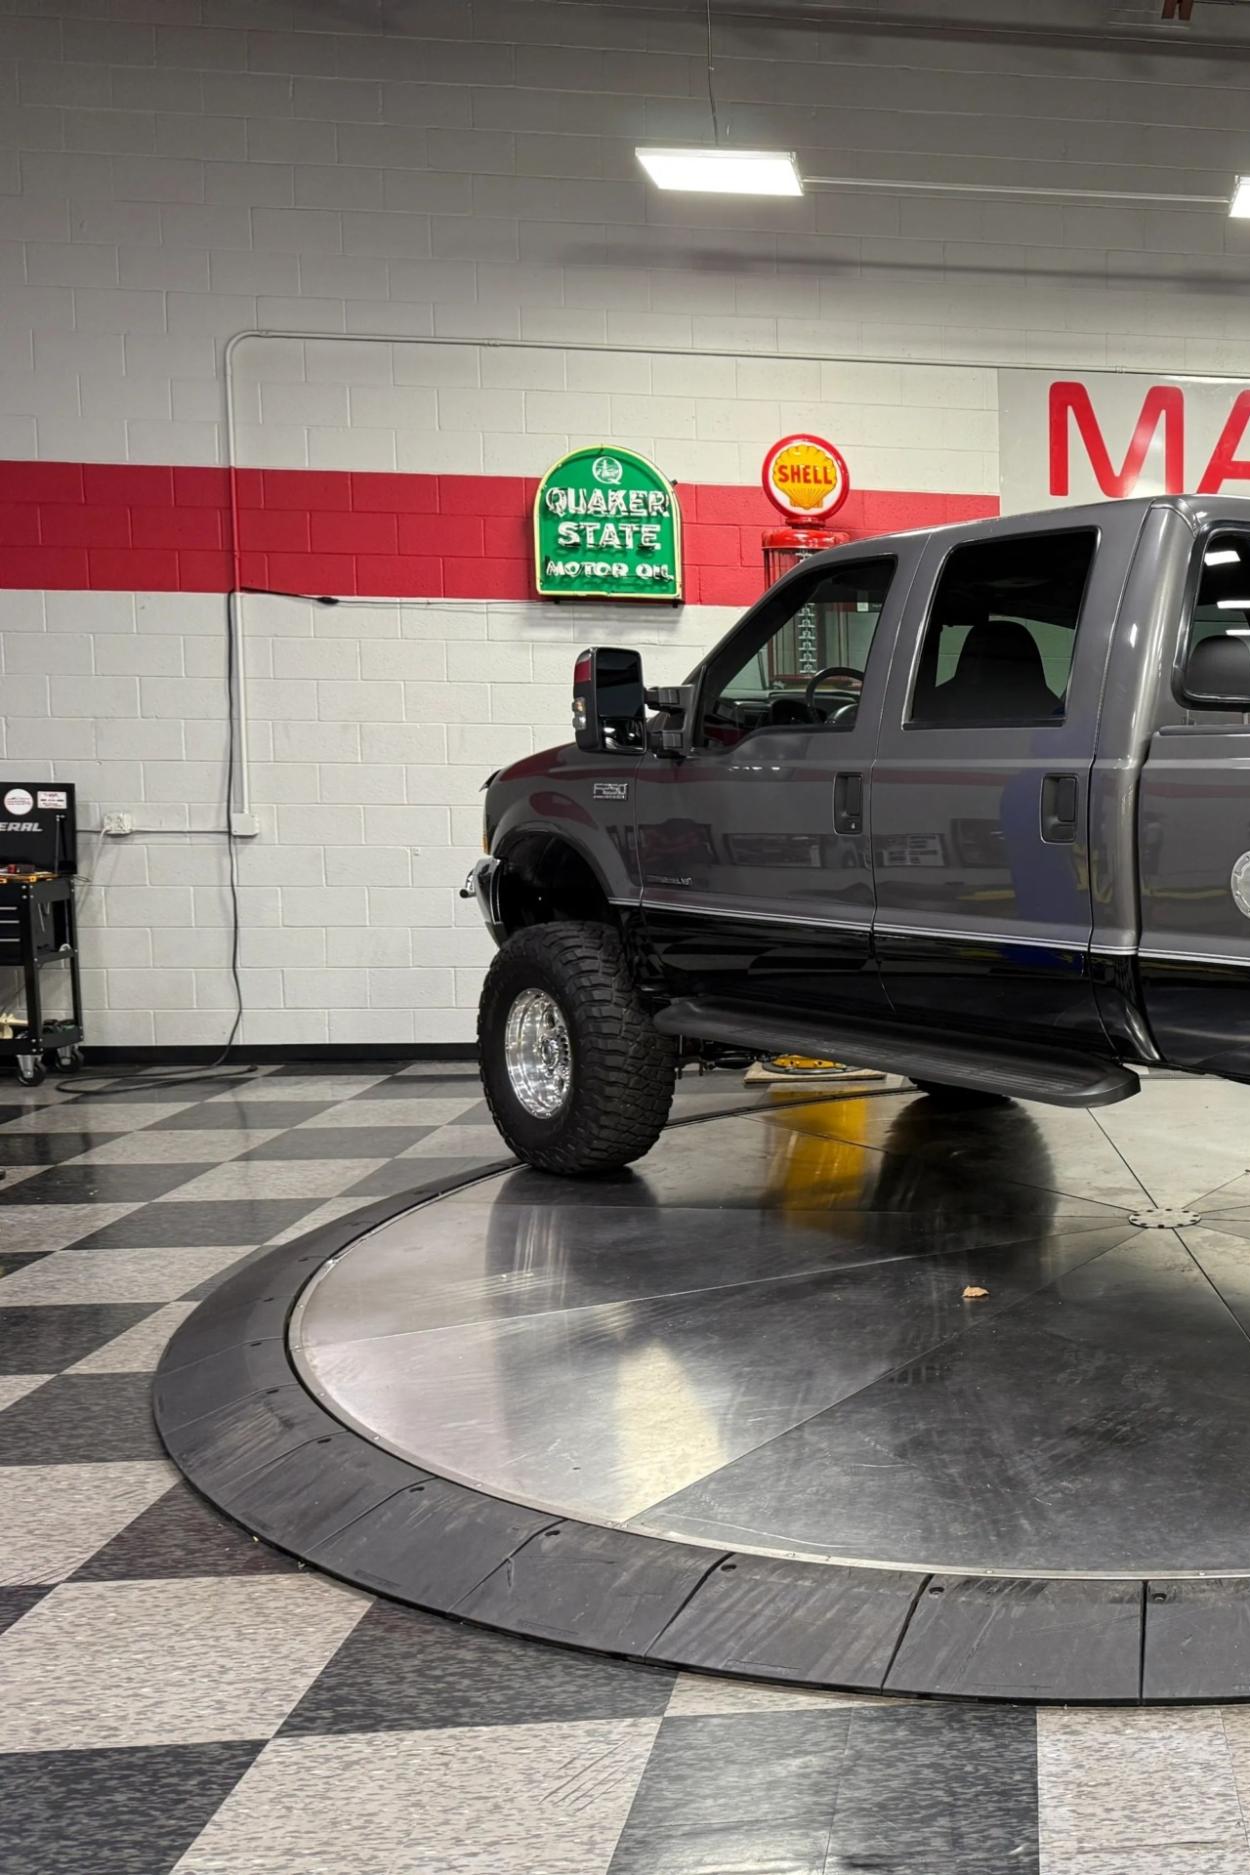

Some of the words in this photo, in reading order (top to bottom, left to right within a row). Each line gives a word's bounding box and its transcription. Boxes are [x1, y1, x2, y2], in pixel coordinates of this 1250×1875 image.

[777, 463, 833, 486] SHELL
[546, 487, 670, 518] QUAKER
[558, 522, 661, 550] STATE
[545, 560, 629, 580] MOTOR
[635, 562, 674, 581] OIL
